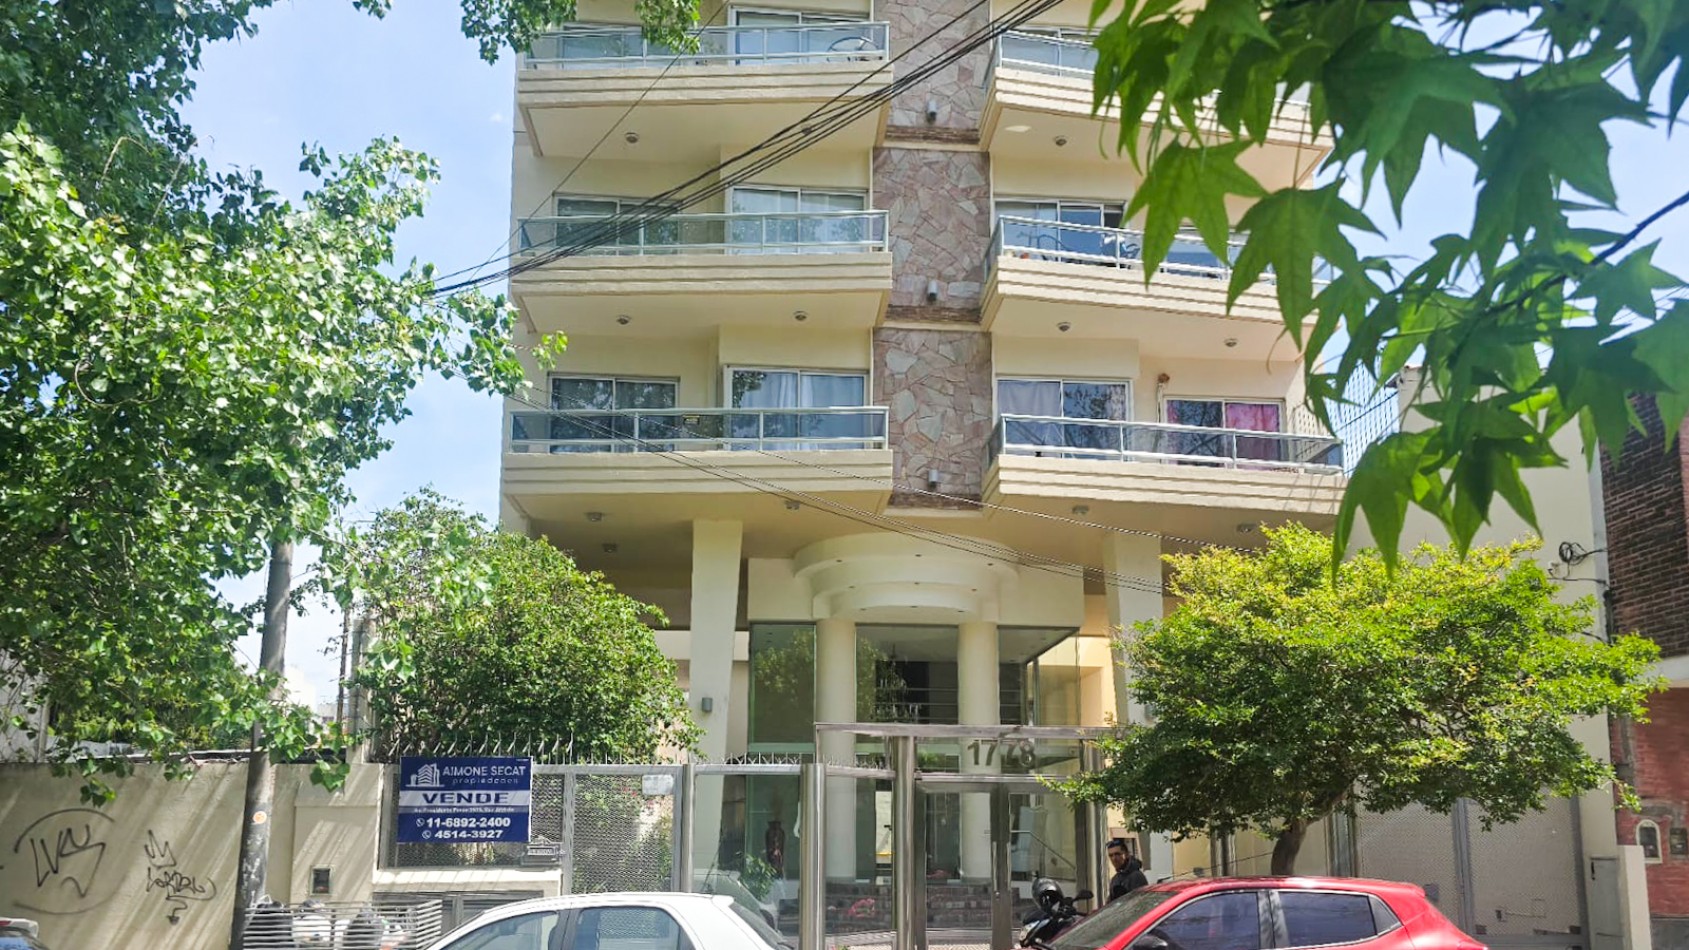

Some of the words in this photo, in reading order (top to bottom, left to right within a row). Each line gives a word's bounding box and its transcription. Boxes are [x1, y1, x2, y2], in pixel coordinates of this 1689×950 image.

[442, 766, 488, 776] AIMONE
[490, 765, 526, 776] SECAT
[422, 792, 510, 804] VENDE
[426, 817, 511, 828] 11-6892-2400
[434, 829, 503, 839] 4514-3927
